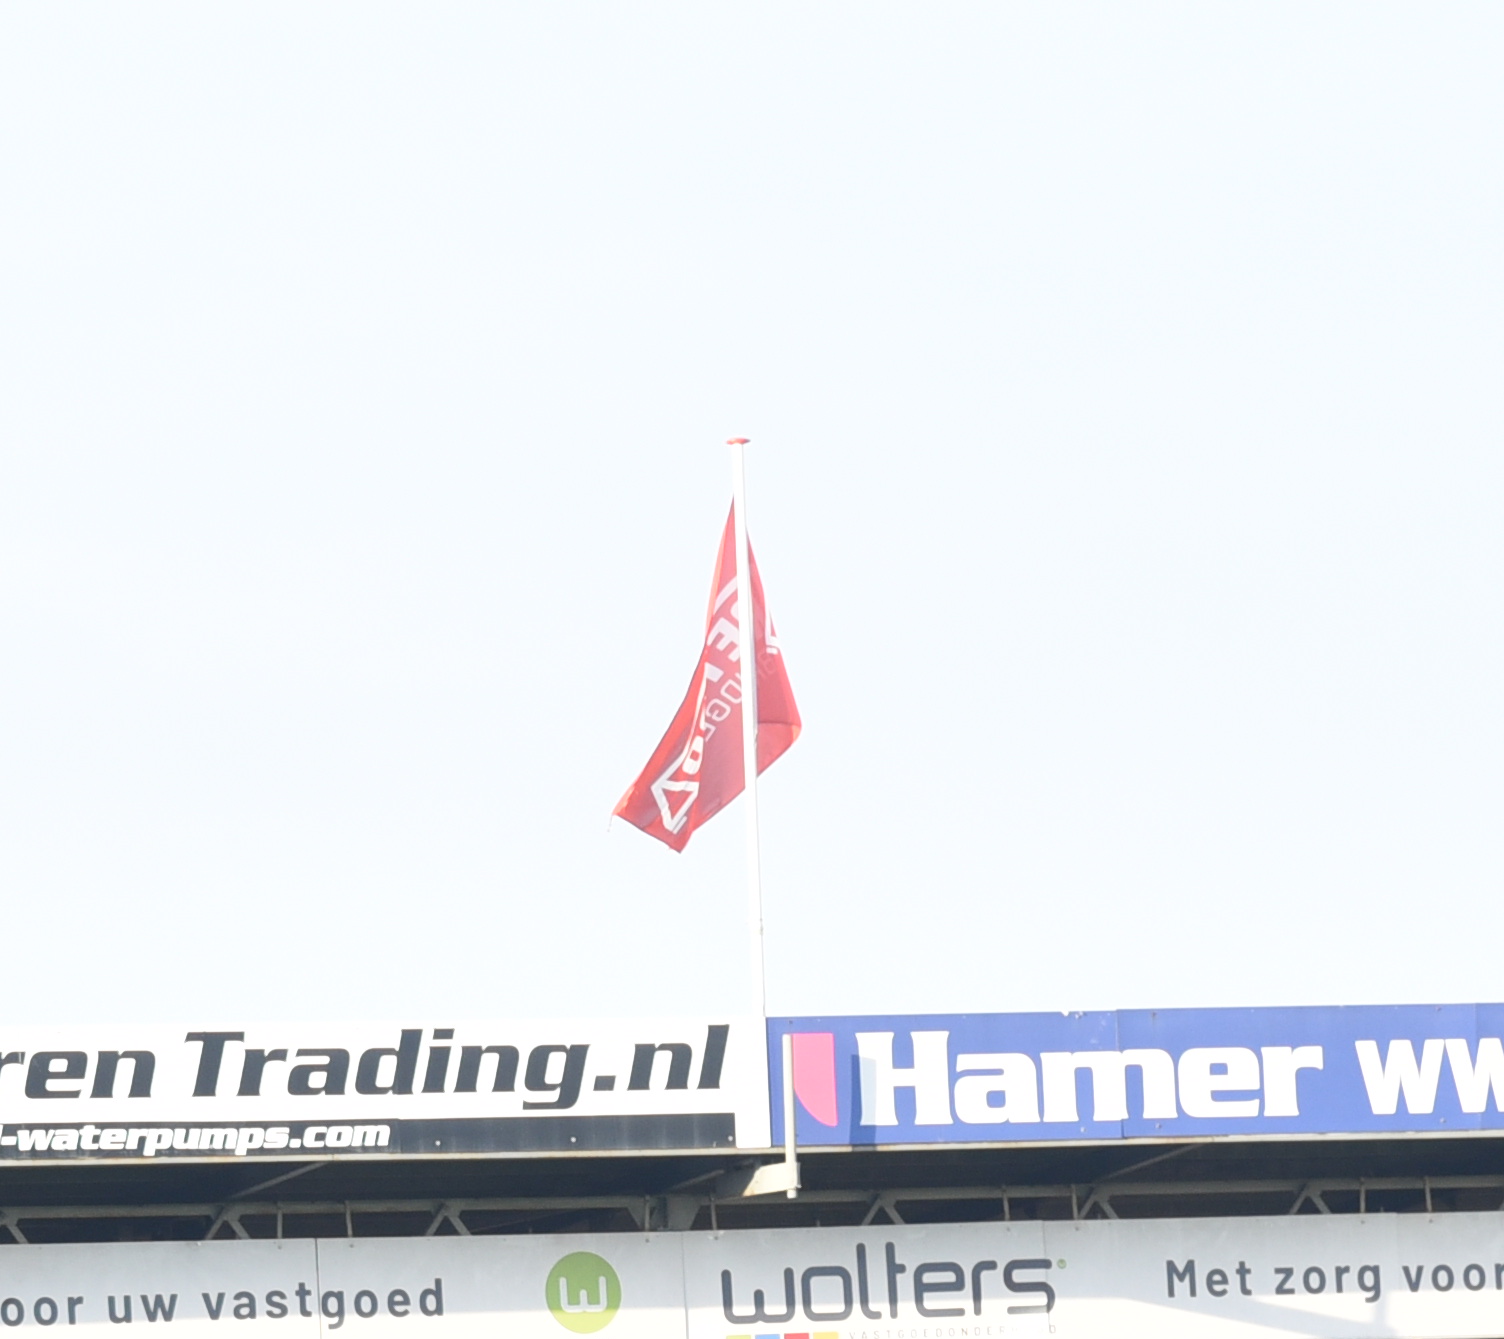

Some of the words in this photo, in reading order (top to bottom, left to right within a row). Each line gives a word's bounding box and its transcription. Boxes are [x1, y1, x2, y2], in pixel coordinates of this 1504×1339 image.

[184, 1024, 731, 1113] Trading.nl
[855, 1028, 1325, 1128] Hamer
[107, 1287, 179, 1325] uw
[203, 1278, 445, 1330] vastgoed
[719, 1241, 1057, 1325] wolters
[1166, 1259, 1254, 1299] Met
[1273, 1260, 1384, 1303] zorg
